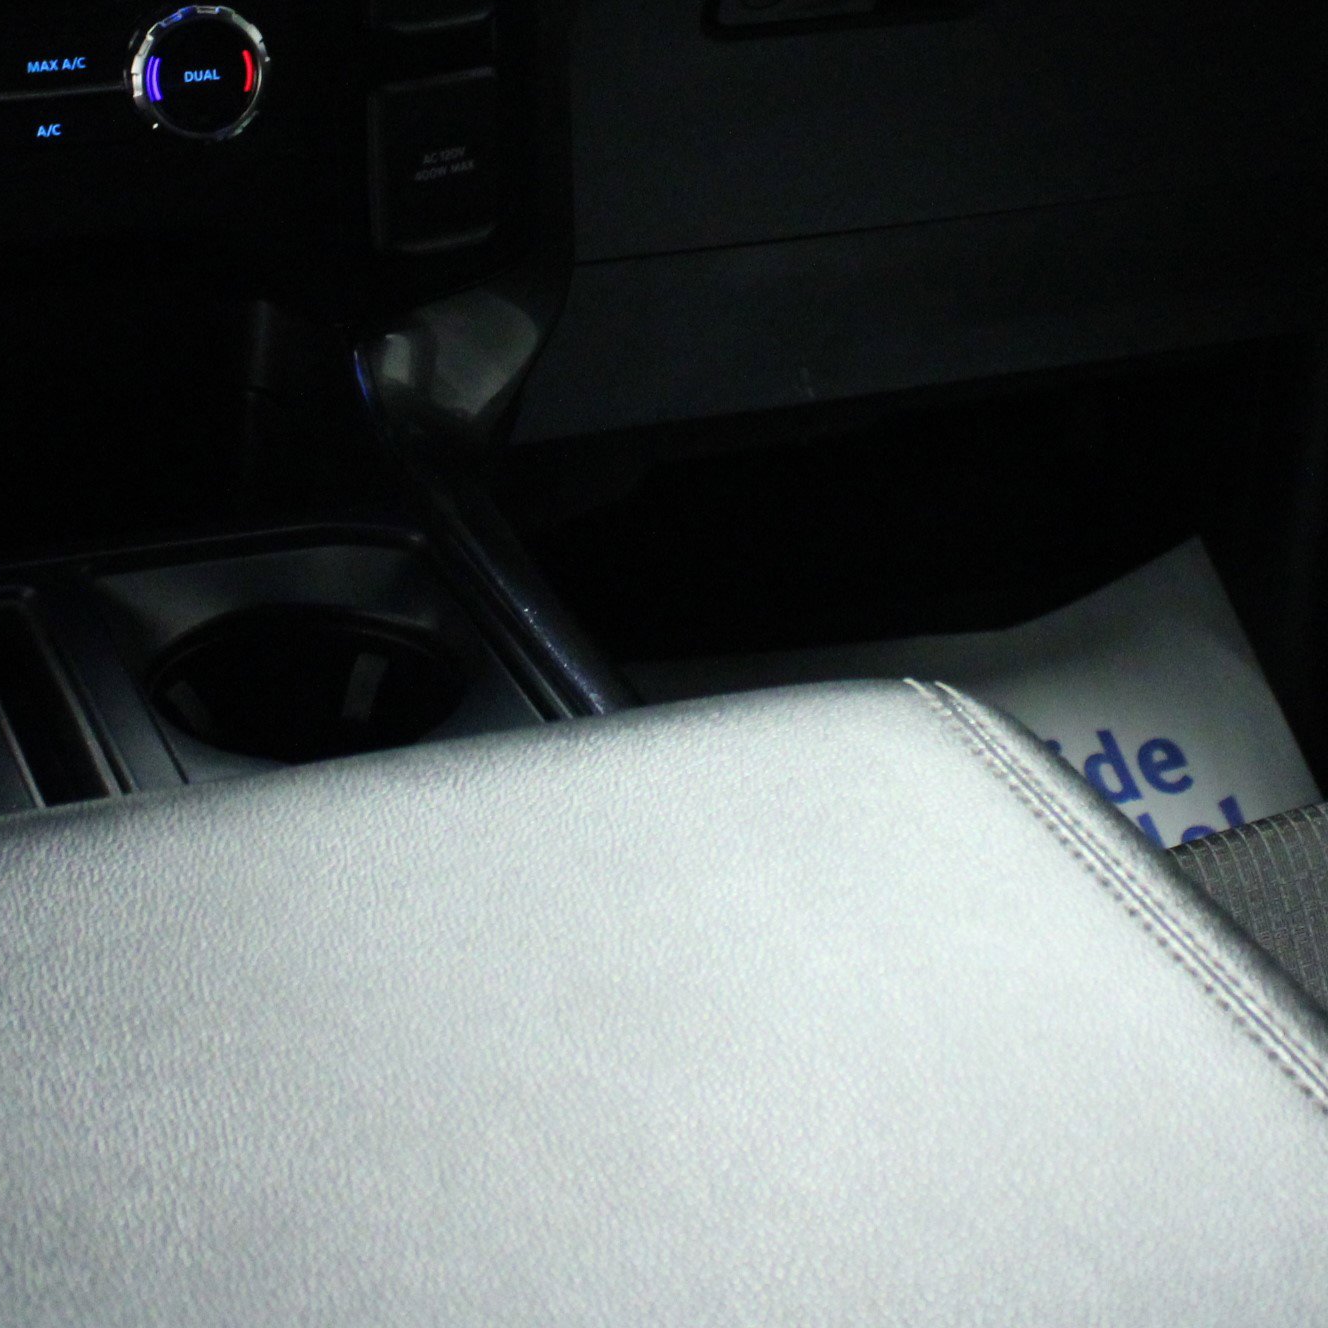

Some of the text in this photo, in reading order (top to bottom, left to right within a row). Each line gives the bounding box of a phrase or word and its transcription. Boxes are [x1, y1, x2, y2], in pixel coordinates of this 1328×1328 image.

[27, 56, 87, 73] MAX A/C
[183, 69, 221, 82] DUAL
[36, 123, 62, 138] A/C
[1044, 728, 1194, 805] de
